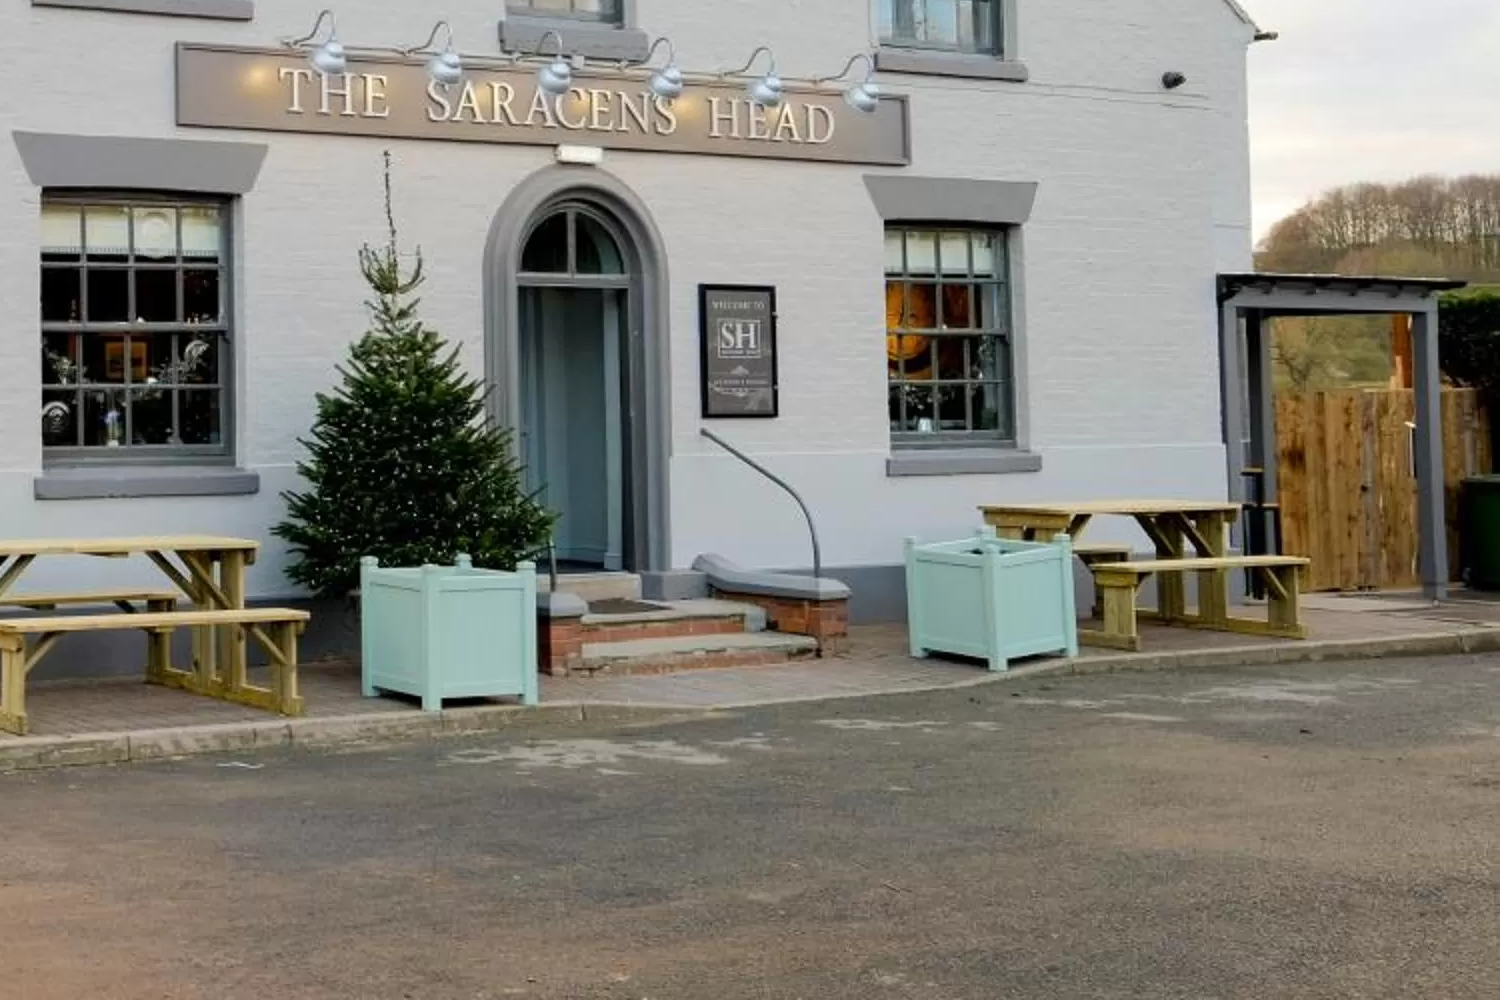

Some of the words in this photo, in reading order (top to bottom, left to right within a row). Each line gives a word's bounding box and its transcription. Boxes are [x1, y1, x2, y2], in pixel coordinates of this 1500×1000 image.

[278, 67, 389, 117] THE
[707, 96, 835, 143] HEAD
[721, 323, 757, 349] SH
